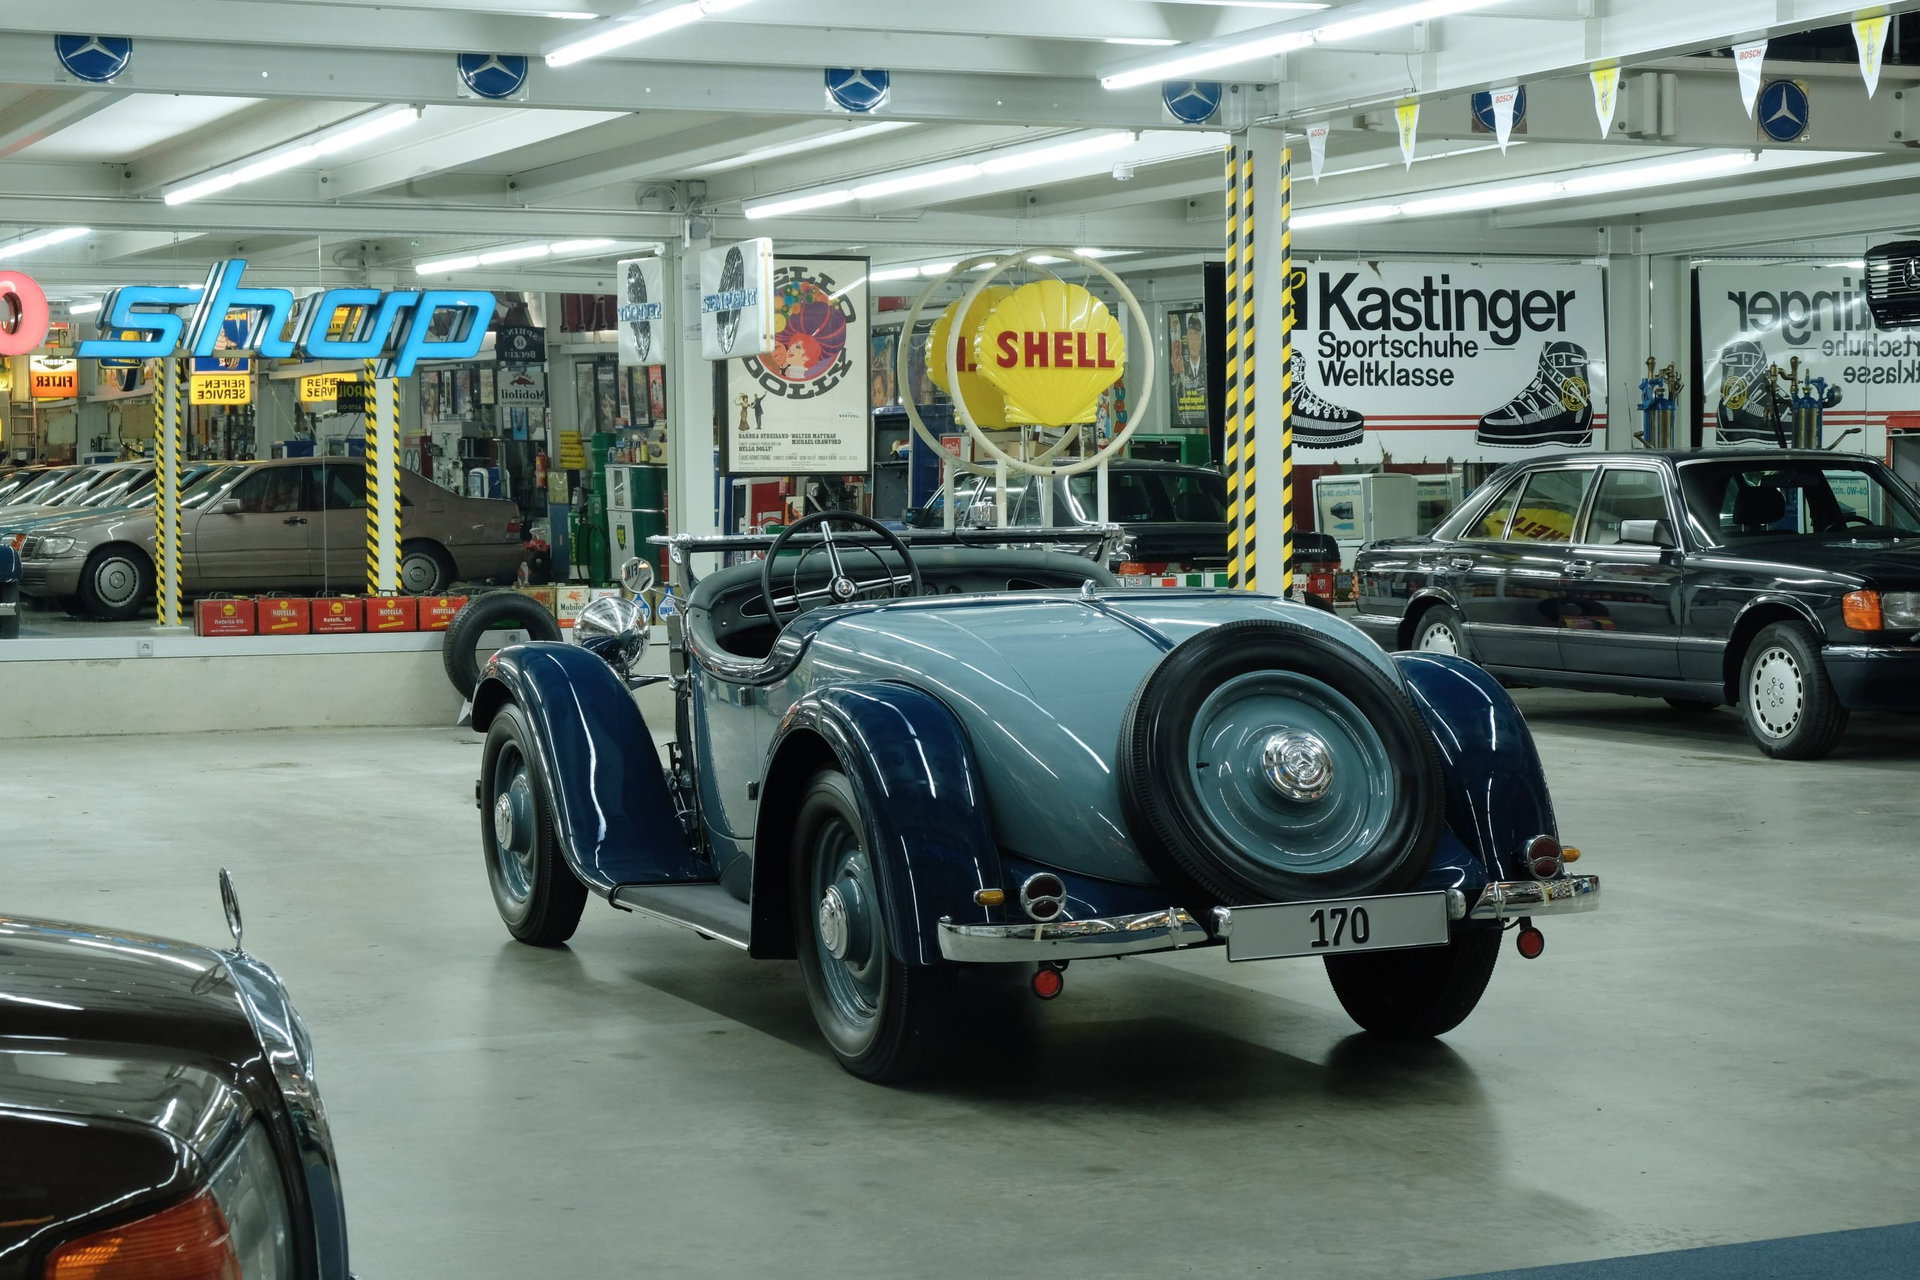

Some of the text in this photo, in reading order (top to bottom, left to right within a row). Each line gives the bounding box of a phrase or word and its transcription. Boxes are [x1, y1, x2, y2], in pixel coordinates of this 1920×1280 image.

[1740, 49, 1761, 60] BOSCH
[1496, 93, 1513, 104] BOSCH
[1311, 129, 1326, 137] BOSCH
[774, 266, 857, 323] ELLO
[1319, 272, 1576, 346] Kastinger
[75, 259, 497, 378] shop
[996, 331, 1115, 369] SHELL
[1318, 331, 1479, 362] Sportschuhe
[742, 348, 853, 400] DOLLY
[1318, 360, 1455, 387] Weltklasse
[1309, 906, 1370, 948] 170
